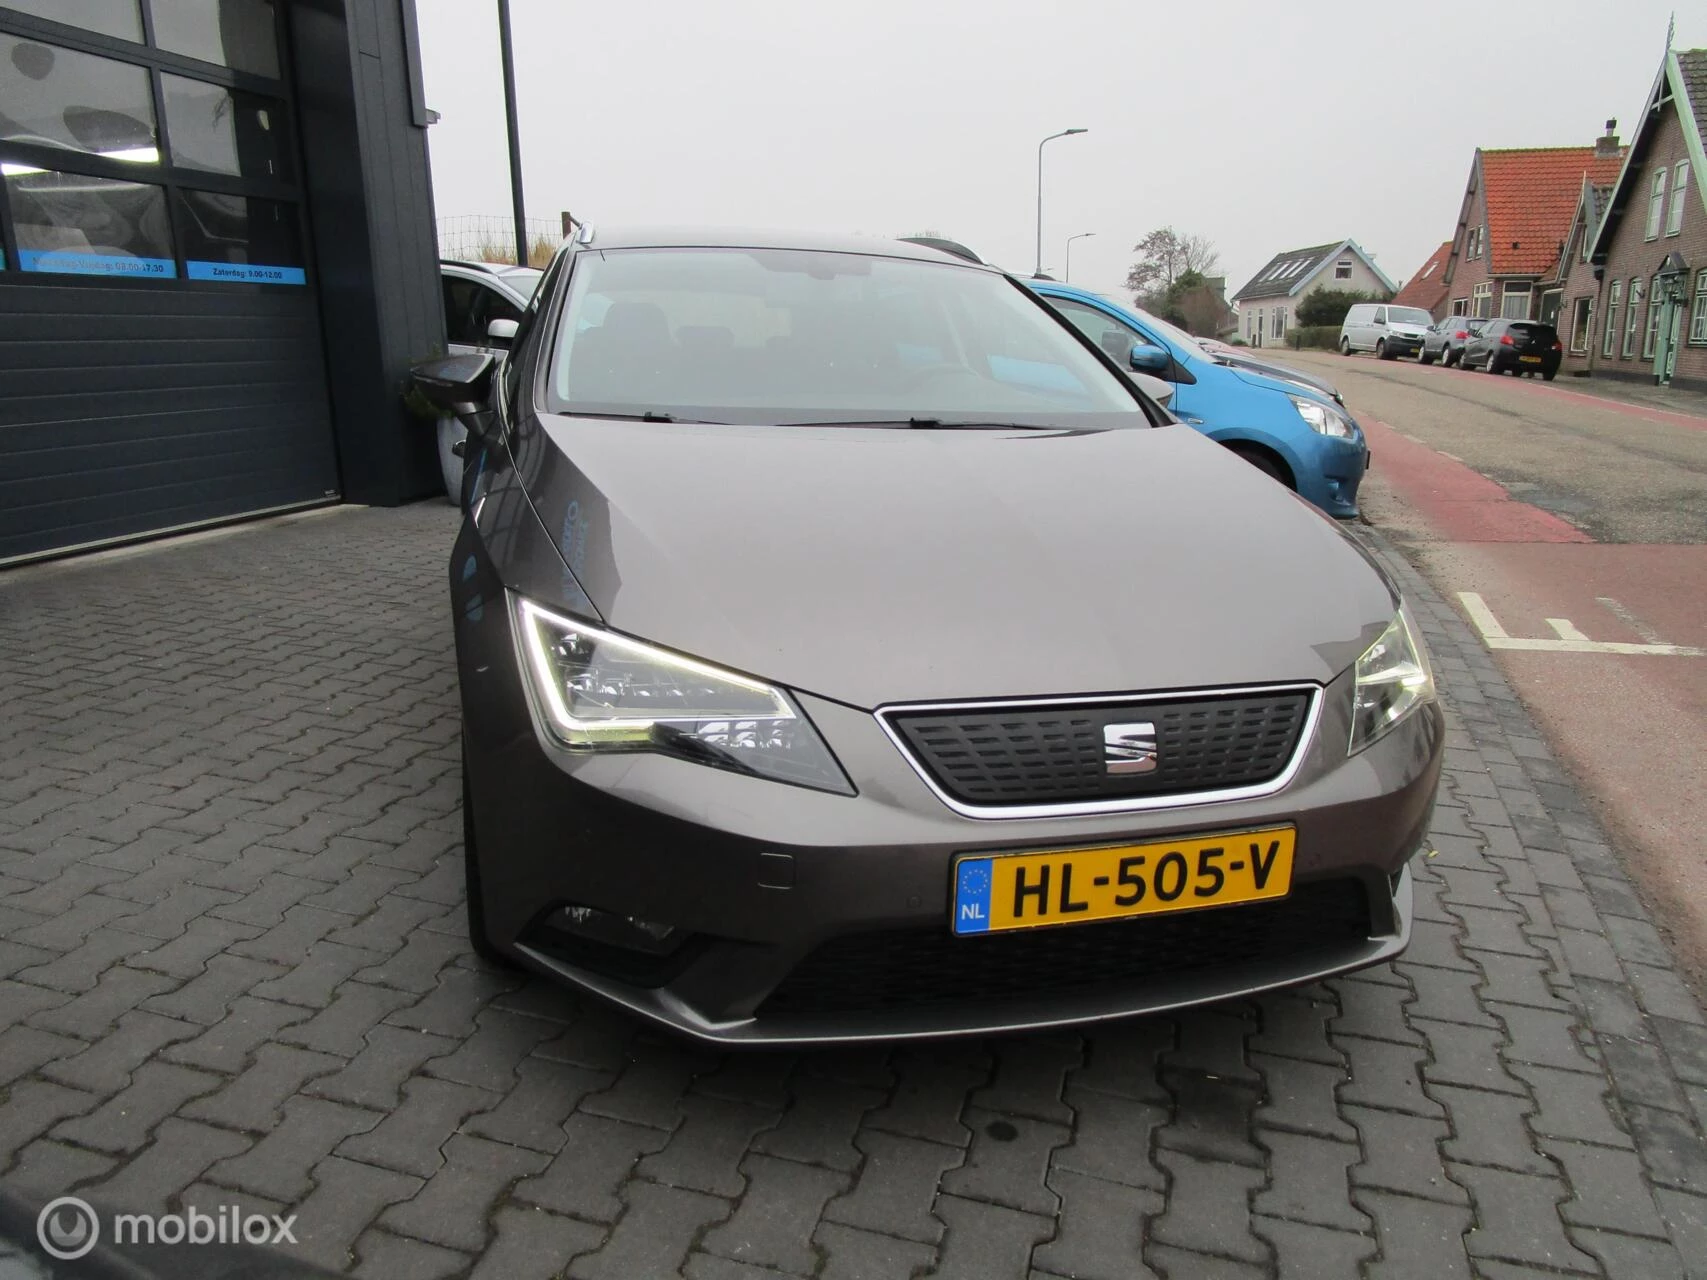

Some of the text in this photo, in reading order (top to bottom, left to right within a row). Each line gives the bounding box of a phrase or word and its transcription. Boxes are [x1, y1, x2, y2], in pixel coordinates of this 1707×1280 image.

[213, 267, 282, 279] Zaterdag: 9.00-12.00
[1013, 840, 1280, 918] HL-505-V
[961, 903, 985, 920] NL
